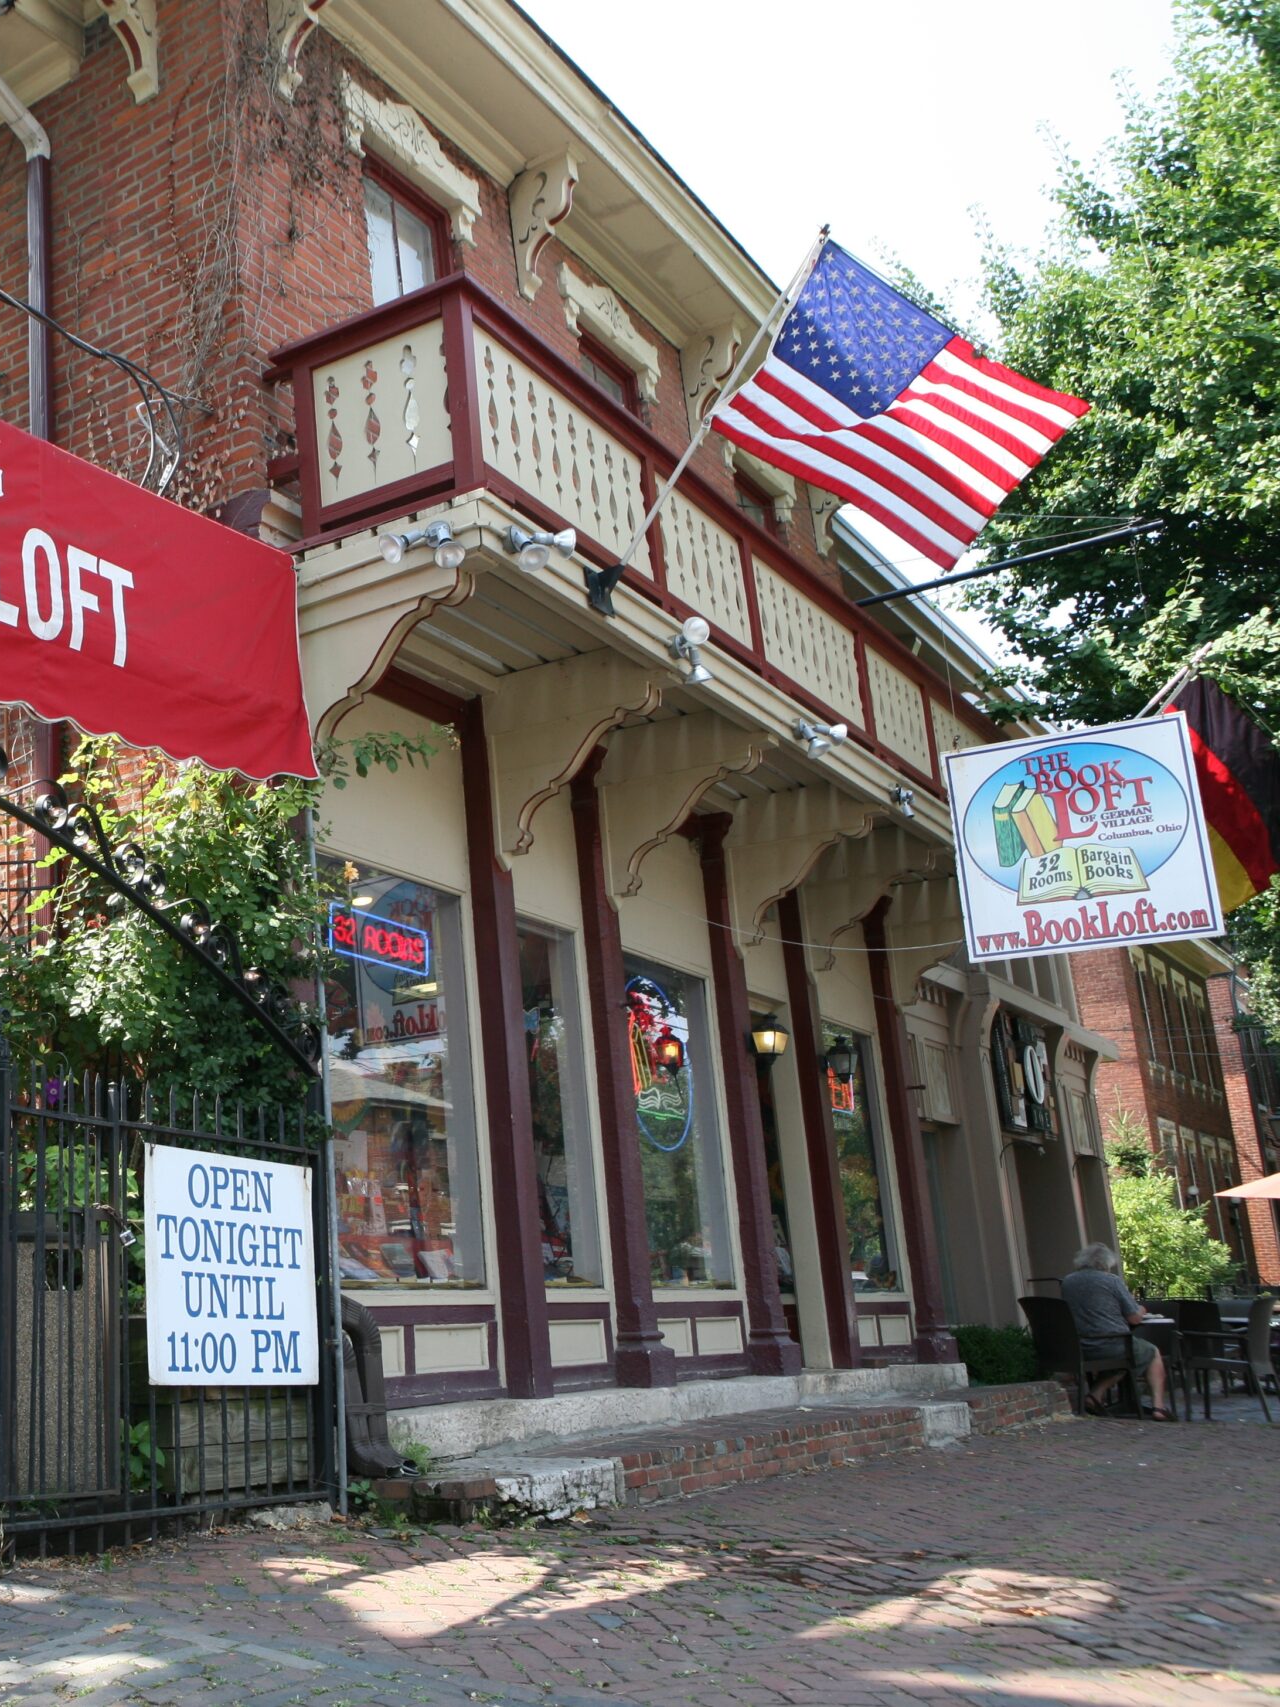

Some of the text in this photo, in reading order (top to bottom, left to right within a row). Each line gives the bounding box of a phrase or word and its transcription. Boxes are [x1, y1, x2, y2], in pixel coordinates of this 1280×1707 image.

[1019, 751, 1070, 775] THE
[1033, 760, 1126, 794] BOOK
[1044, 776, 1153, 841] LOFT
[1080, 806, 1152, 824] OF GERMAN
[1101, 815, 1154, 829] VILLAGE
[1098, 824, 1182, 842] Columbus, Ohio
[1035, 853, 1060, 876] 32
[1081, 848, 1132, 866] Bargain
[1029, 870, 1073, 891] Rooms
[1085, 864, 1134, 881] Books
[334, 915, 357, 946] 32
[976, 898, 1210, 953] www.BookLoft.com
[188, 1163, 273, 1214] OPEN
[157, 1213, 303, 1270] TONIGHT
[181, 1271, 285, 1320] UNTIL
[167, 1329, 302, 1374] 11:00 PM
